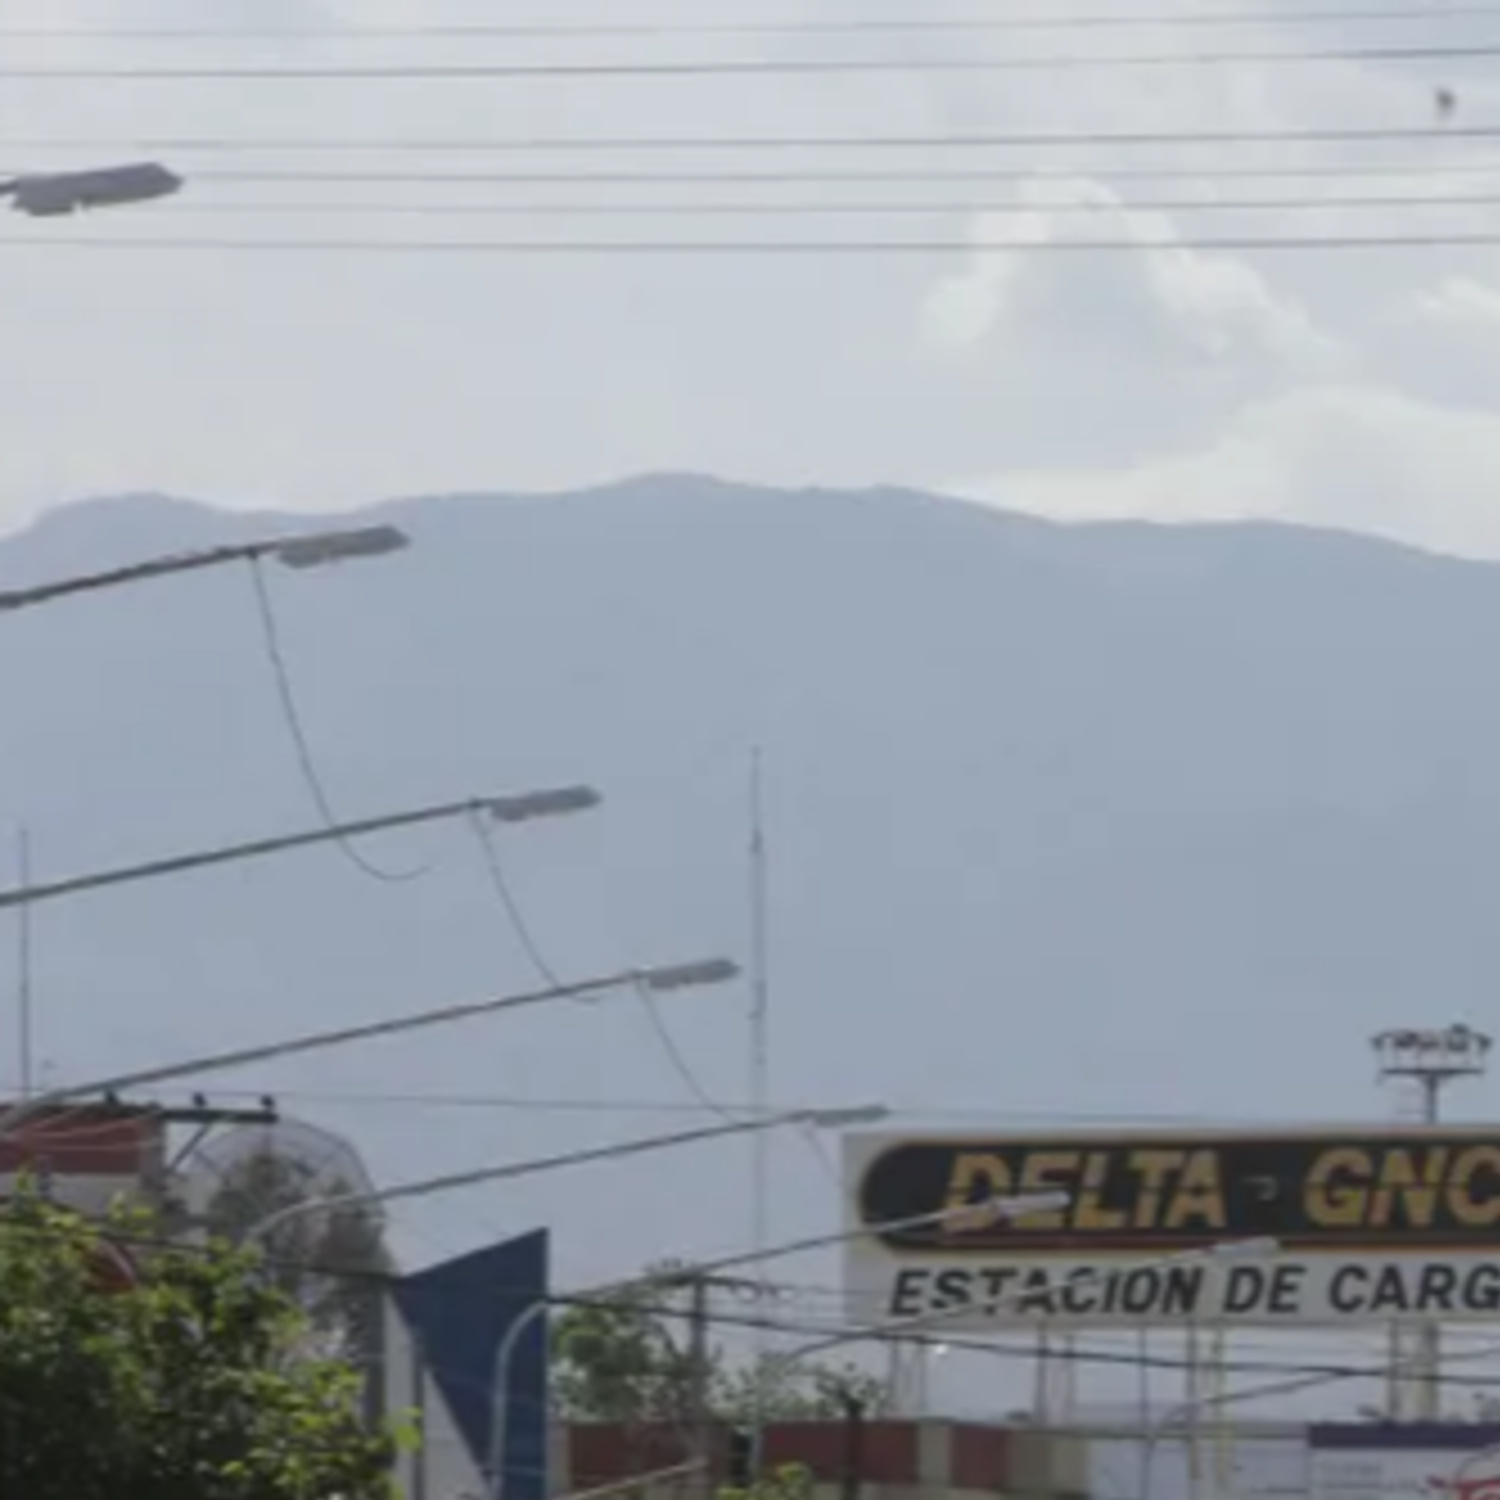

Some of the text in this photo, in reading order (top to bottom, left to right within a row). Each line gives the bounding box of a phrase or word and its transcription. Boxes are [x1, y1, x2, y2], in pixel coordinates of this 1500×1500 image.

[941, 1149, 1228, 1232] DELTA
[889, 1266, 1204, 1317] ESTACION
[1222, 1264, 1307, 1314] DE
